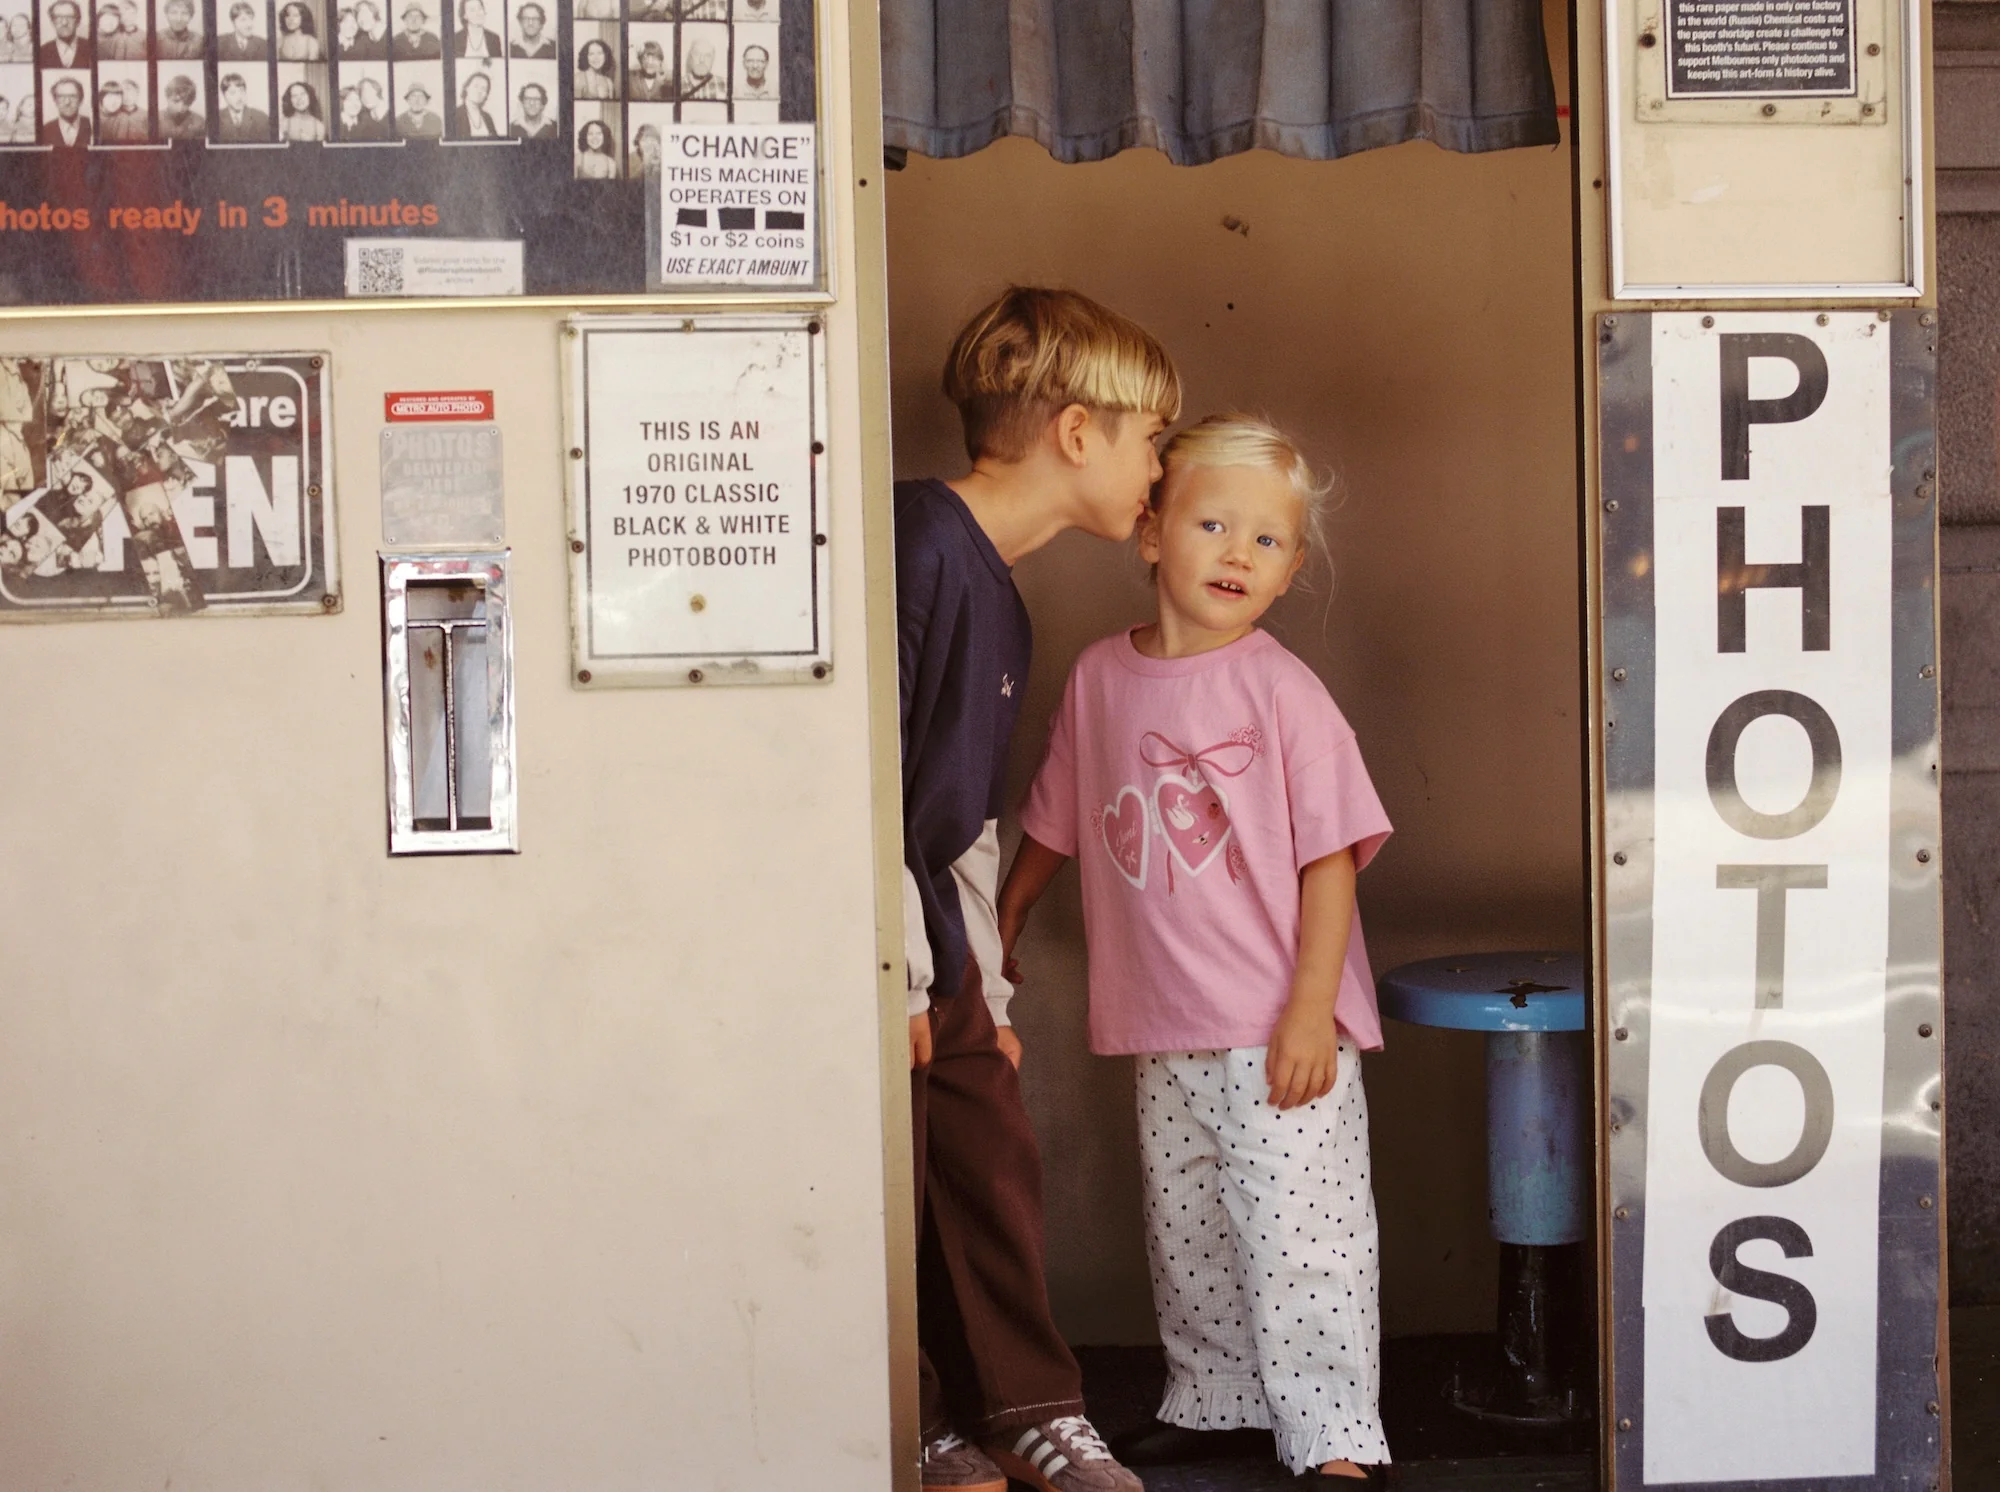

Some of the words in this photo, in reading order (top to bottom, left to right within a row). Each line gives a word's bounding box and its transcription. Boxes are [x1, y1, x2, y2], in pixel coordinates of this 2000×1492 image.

[1679, 3, 1695, 13] this
[1696, 4, 1714, 13] rare
[1715, 3, 1740, 14] paper
[1740, 2, 1764, 12] made
[1766, 2, 1774, 11] in
[1775, 1, 1793, 12] only
[1795, 2, 1811, 11] one
[1812, 1, 1842, 12] factory
[1678, 16, 1686, 26] in
[1687, 16, 1701, 26] the
[1702, 15, 1727, 26] world
[1728, 15, 1762, 26] (Russia)
[1763, 14, 1802, 25] Chemical
[1803, 14, 1826, 24] costs
[1827, 13, 1844, 24] and
[1677, 29, 1691, 40] the
[1692, 30, 1717, 41] paper
[1718, 28, 1755, 40] shortage
[1756, 28, 1782, 38] create
[1783, 29, 1790, 38] a
[1791, 27, 1831, 39] challenge
[1832, 27, 1844, 37] for
[1685, 42, 1701, 53] this
[1702, 42, 1733, 52] booth's
[1734, 41, 1761, 52] future.
[1763, 41, 1790, 51] Please
[1791, 40, 1827, 51] continue
[1828, 40, 1838, 50] to
[1678, 56, 1710, 68] support
[1761, 54, 1779, 66] only
[1780, 53, 1828, 66] photobooth
[1829, 53, 1845, 63] and
[1687, 69, 1721, 81] keeping
[1722, 69, 1738, 79] this
[1740, 68, 1774, 78] art-form
[1776, 68, 1783, 78] &
[1784, 67, 1813, 79] history
[1814, 67, 1837, 77] alive.
[668, 166, 712, 182] THIS
[719, 168, 809, 184] MACHINE
[669, 189, 772, 205] OPERATES
[778, 191, 806, 205] ON
[0, 201, 91, 231] hotos
[109, 201, 201, 236] ready
[218, 201, 248, 228] in
[262, 196, 289, 228] 3
[308, 198, 440, 228] minutes
[670, 230, 692, 247] $1
[700, 235, 720, 247] or
[725, 231, 748, 248] $2
[755, 233, 805, 249] coins
[666, 257, 695, 275] USE
[698, 258, 745, 275] EXACT
[747, 259, 810, 276] AMOUNT
[224, 396, 297, 428] are
[639, 421, 690, 441] THIS
[700, 421, 721, 441] IS
[730, 420, 760, 441] AN
[647, 452, 755, 474] ORIGINAL
[623, 484, 676, 504] 1970
[685, 483, 780, 503] CLASSIC
[613, 516, 687, 536] BLACK
[695, 515, 711, 535] &
[720, 514, 791, 535] WHITE
[628, 546, 777, 567] PHOTOBOOTH
[1698, 332, 1843, 1363] PHOTOS
